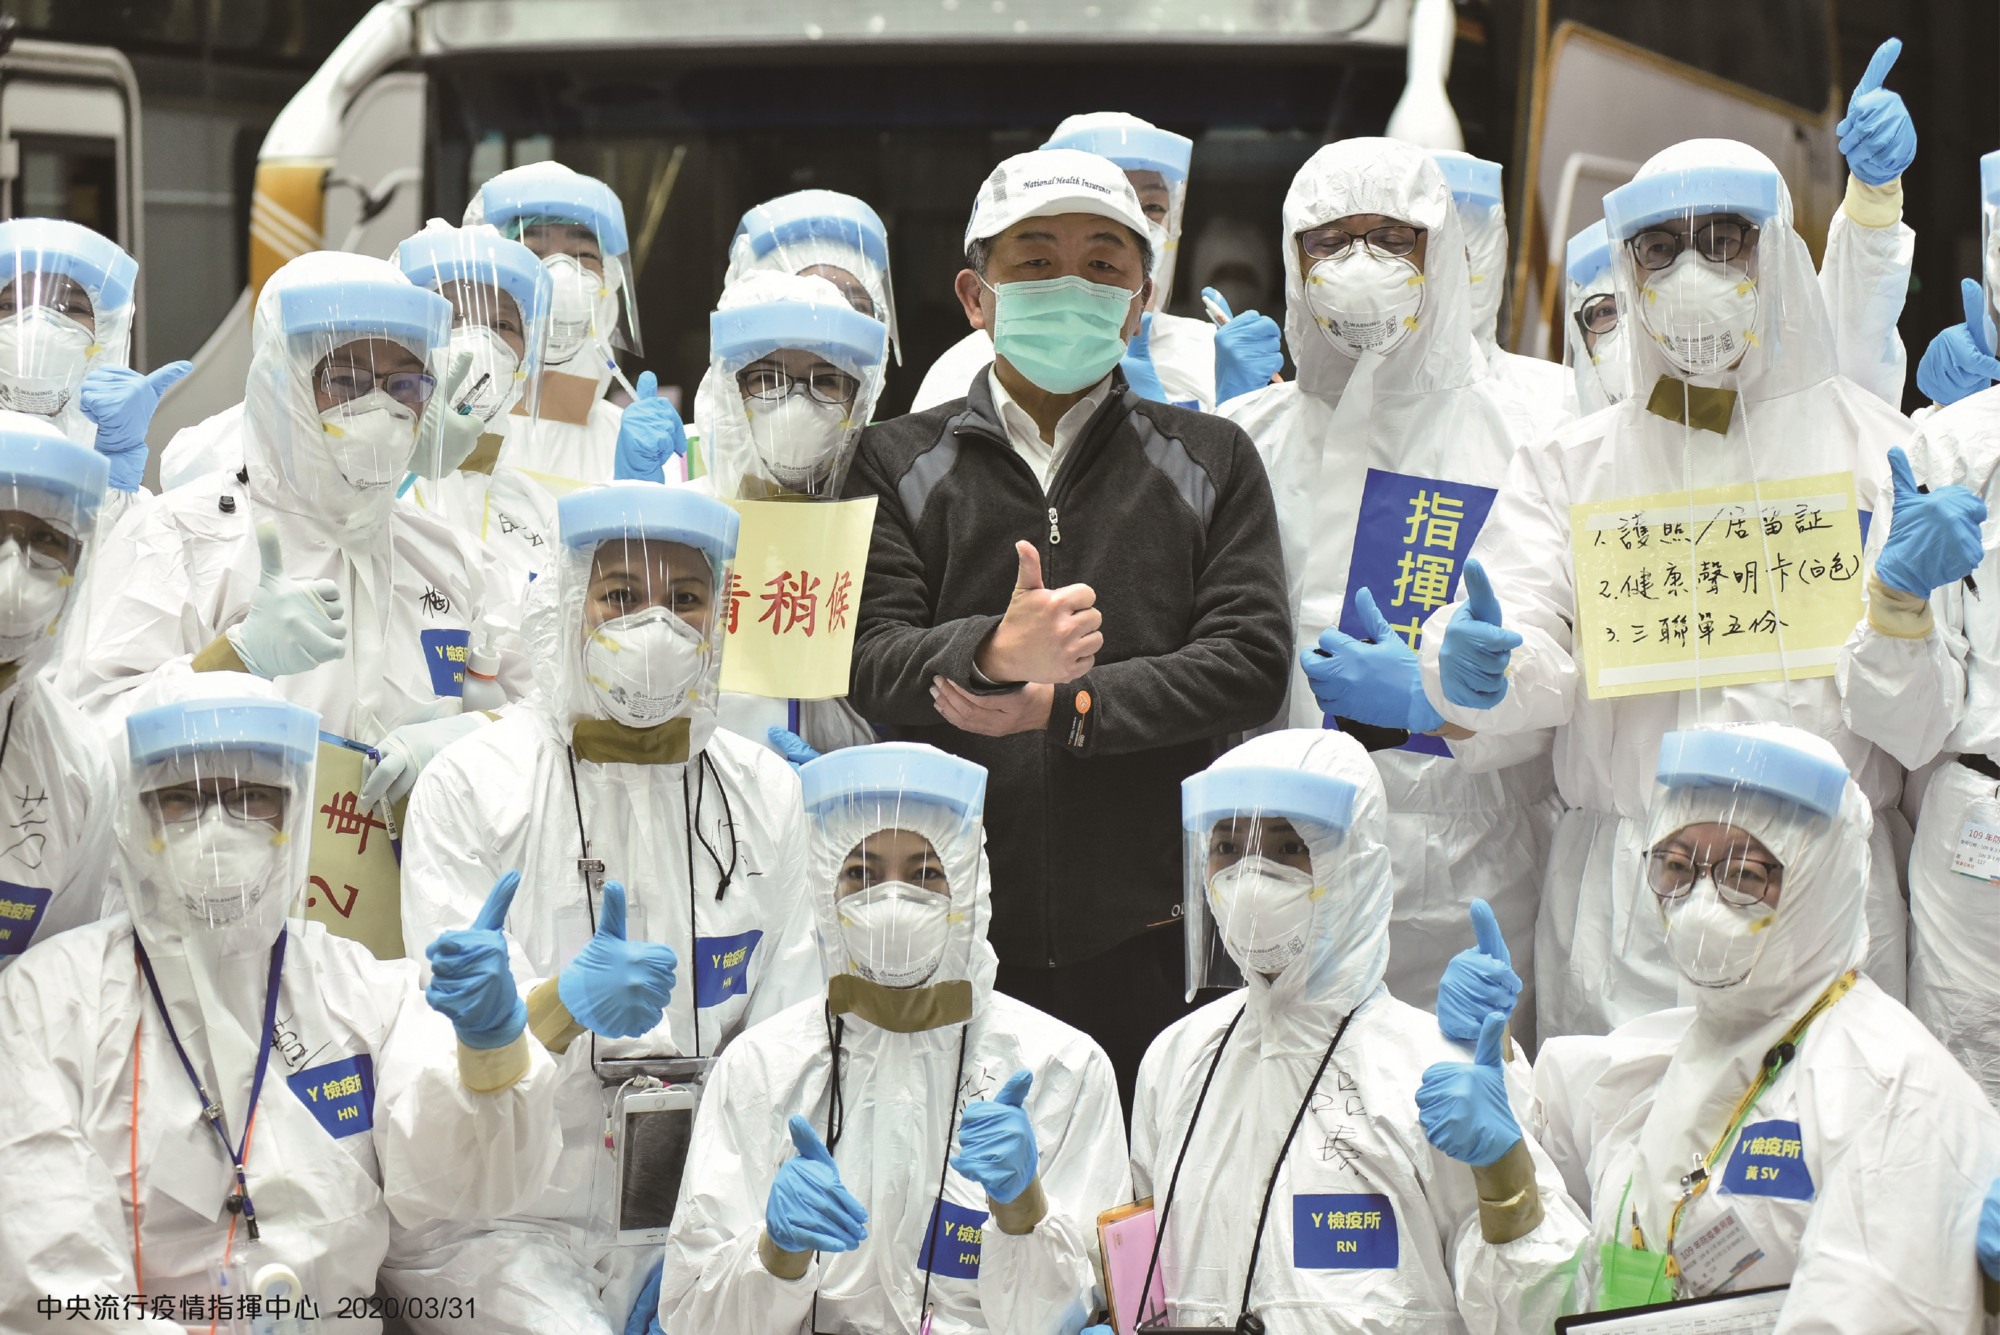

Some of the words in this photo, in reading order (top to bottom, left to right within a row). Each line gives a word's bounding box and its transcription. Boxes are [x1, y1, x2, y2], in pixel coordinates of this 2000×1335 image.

[1022, 176, 1056, 190] National
[1056, 175, 1081, 186] Health
[1081, 178, 1112, 195] Insurance
[435, 646, 444, 659] Y
[453, 672, 464, 683] HN
[712, 954, 721, 969] Y
[723, 946, 747, 969] 檢疫所
[723, 976, 732, 988] HN
[307, 1086, 319, 1102] Y
[337, 1105, 359, 1121] HN
[1742, 1140, 1752, 1154] Y
[1750, 1136, 1802, 1160] 檢疫所
[1760, 1166, 1780, 1181] SV
[945, 1220, 955, 1236] Y
[1311, 1212, 1324, 1228] Y
[1327, 1211, 1381, 1230] 檢疫所
[1336, 1240, 1357, 1253] RN
[959, 1253, 980, 1265] HN
